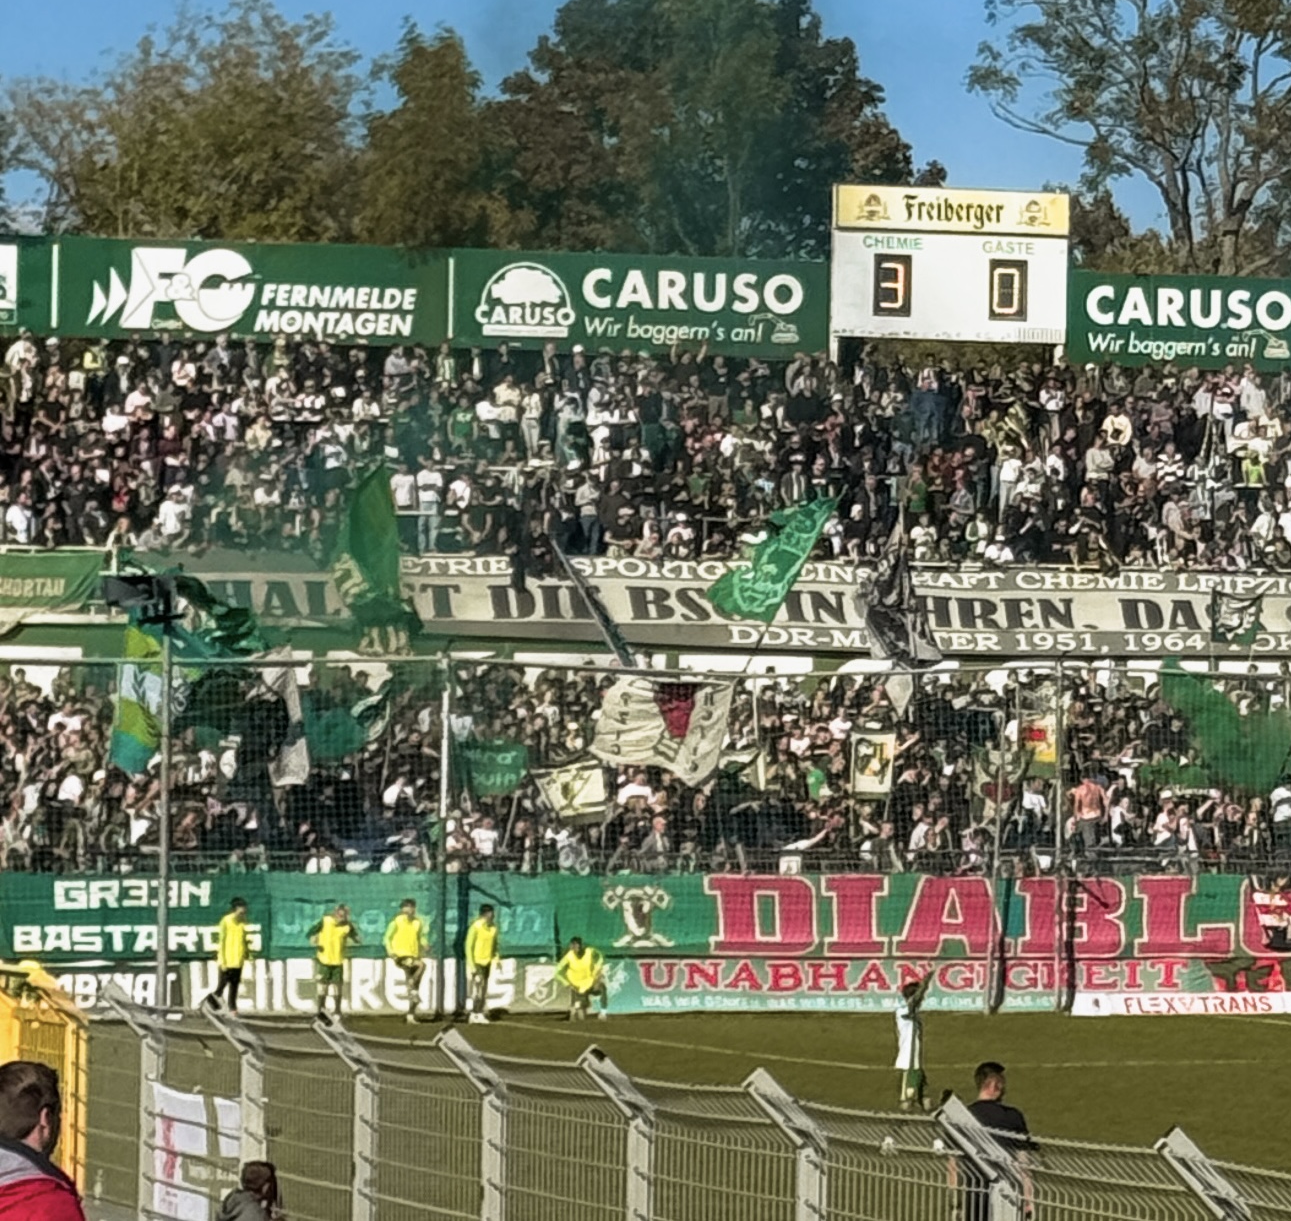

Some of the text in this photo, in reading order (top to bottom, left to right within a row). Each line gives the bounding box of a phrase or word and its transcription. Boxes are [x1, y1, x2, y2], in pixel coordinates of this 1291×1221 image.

[902, 194, 1004, 229] Freiberger
[863, 235, 923, 250] CHEMIE
[261, 282, 417, 310] FERNMELDE
[582, 268, 803, 315] CARUSO
[879, 262, 904, 309] 3
[991, 267, 1020, 314] 0
[253, 311, 413, 336] MONTAGEN
[475, 304, 576, 326] CARUSO
[584, 315, 622, 337] Wir
[1087, 331, 1125, 352] Wir
[1016, 571, 1166, 591] CHEMIE
[625, 585, 748, 622] BS
[729, 626, 1001, 651] DDR-MTER
[1124, 633, 1206, 651] 1964
